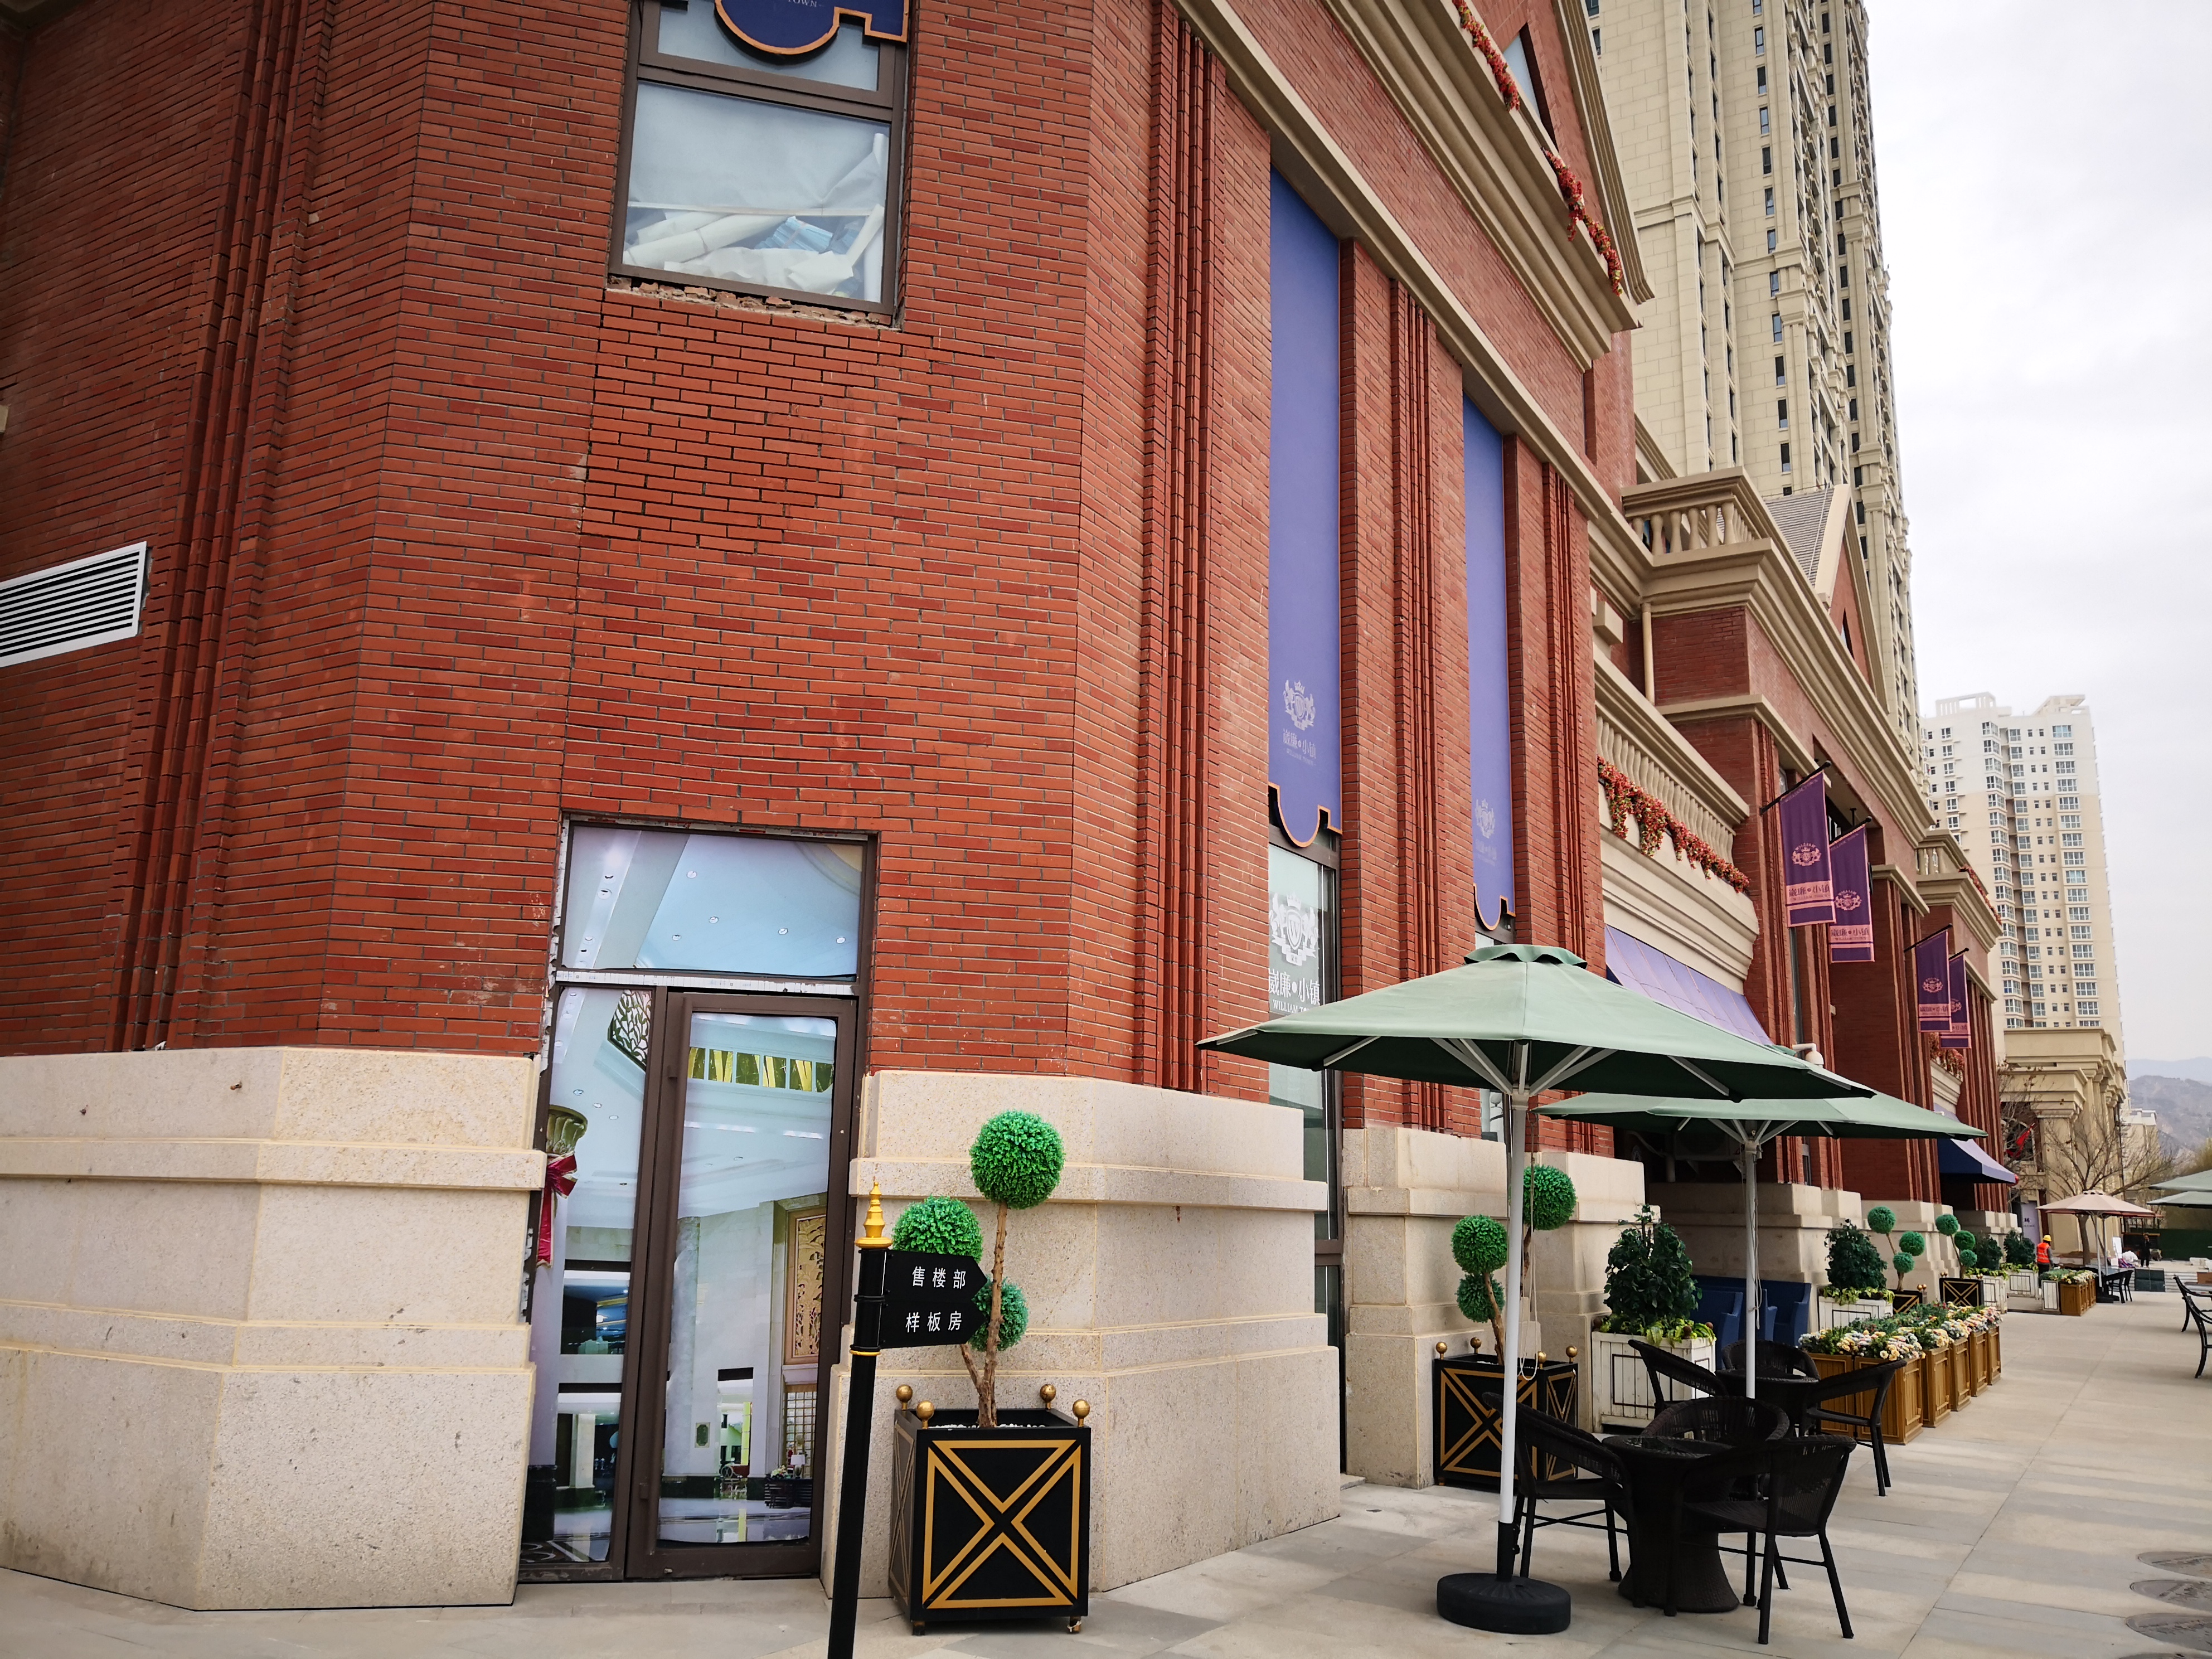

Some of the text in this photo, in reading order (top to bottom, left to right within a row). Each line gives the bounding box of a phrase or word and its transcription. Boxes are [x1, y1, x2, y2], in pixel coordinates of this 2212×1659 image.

[1273, 999, 1298, 1013] WILLIAM
[912, 1266, 966, 1289] 售楼部
[905, 1311, 962, 1333] 样板房
